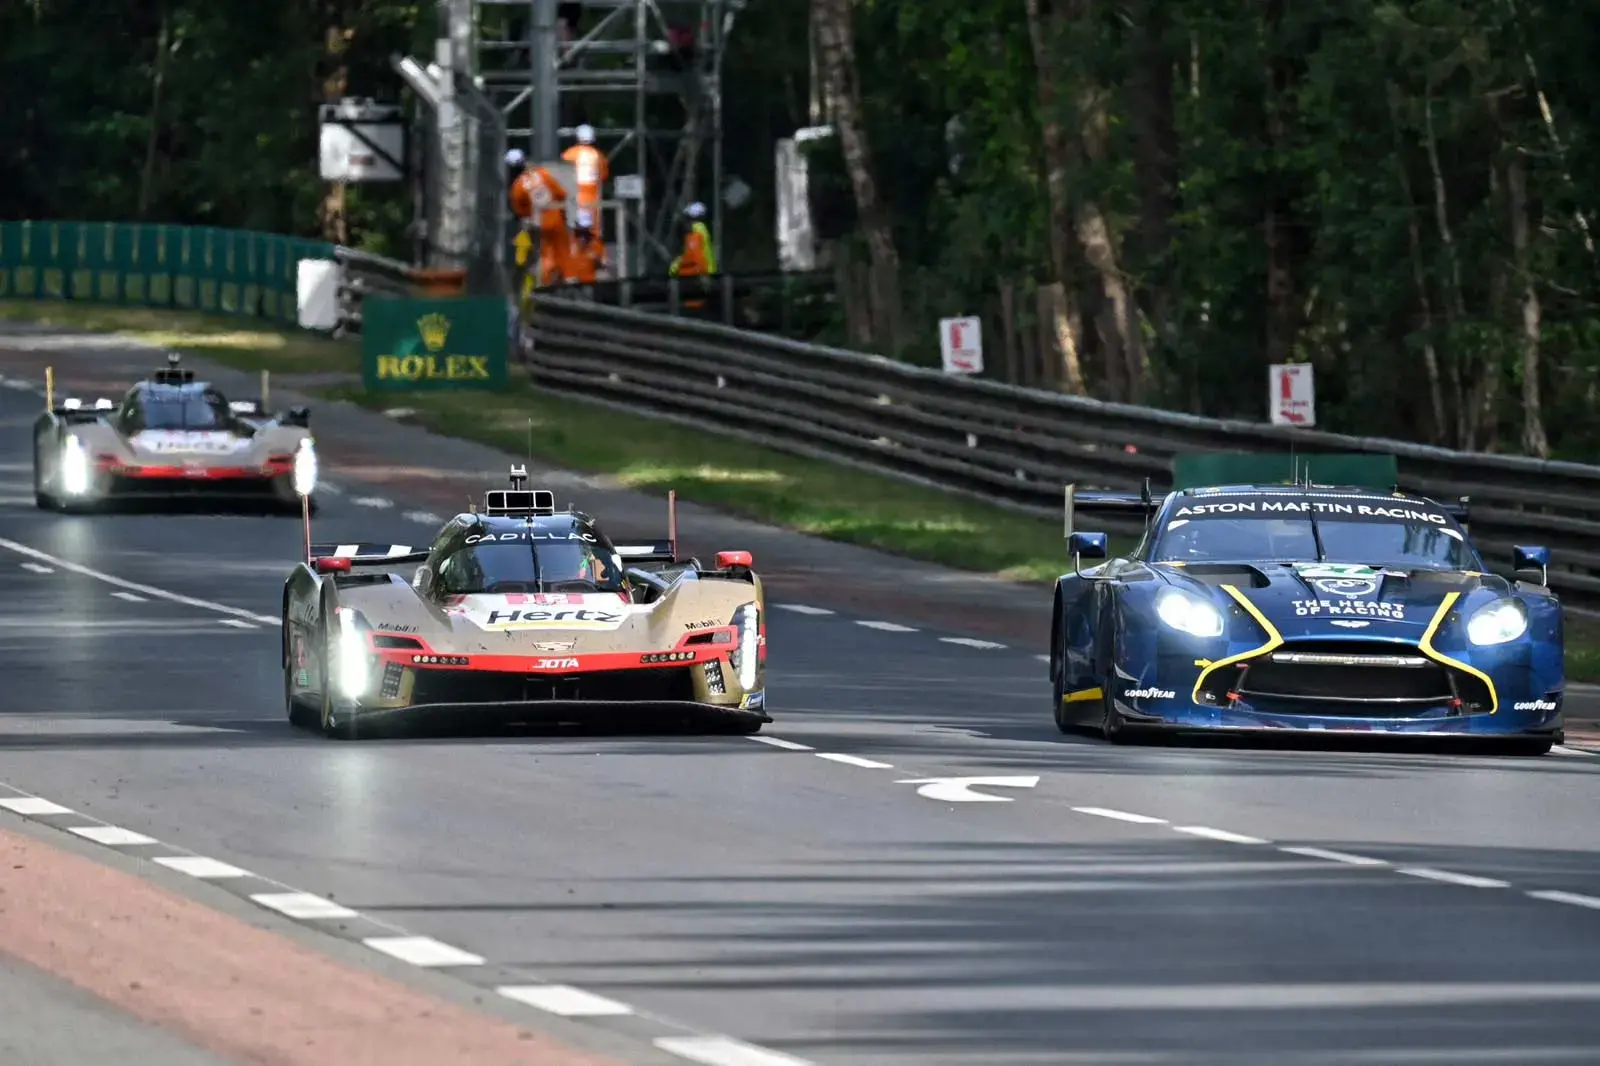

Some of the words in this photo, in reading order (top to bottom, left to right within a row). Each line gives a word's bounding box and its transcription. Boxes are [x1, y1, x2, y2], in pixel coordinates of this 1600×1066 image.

[376, 354, 490, 380] ROLEX
[1176, 502, 1256, 516] ASTON
[1262, 502, 1353, 514] MARTIN
[1358, 505, 1447, 525] RACING
[465, 532, 597, 544] CADILLAC
[1292, 600, 1331, 608] THE
[1339, 600, 1404, 611] HEART
[486, 609, 622, 625] Hertz
[1296, 607, 1321, 616] OF
[1329, 606, 1404, 619] RACING
[378, 623, 409, 632] Mobil
[685, 620, 714, 630] Mobil
[532, 658, 579, 669] JOTA
[1124, 687, 1176, 699] GOODYEAR
[1513, 700, 1556, 711] GOODYEAR
